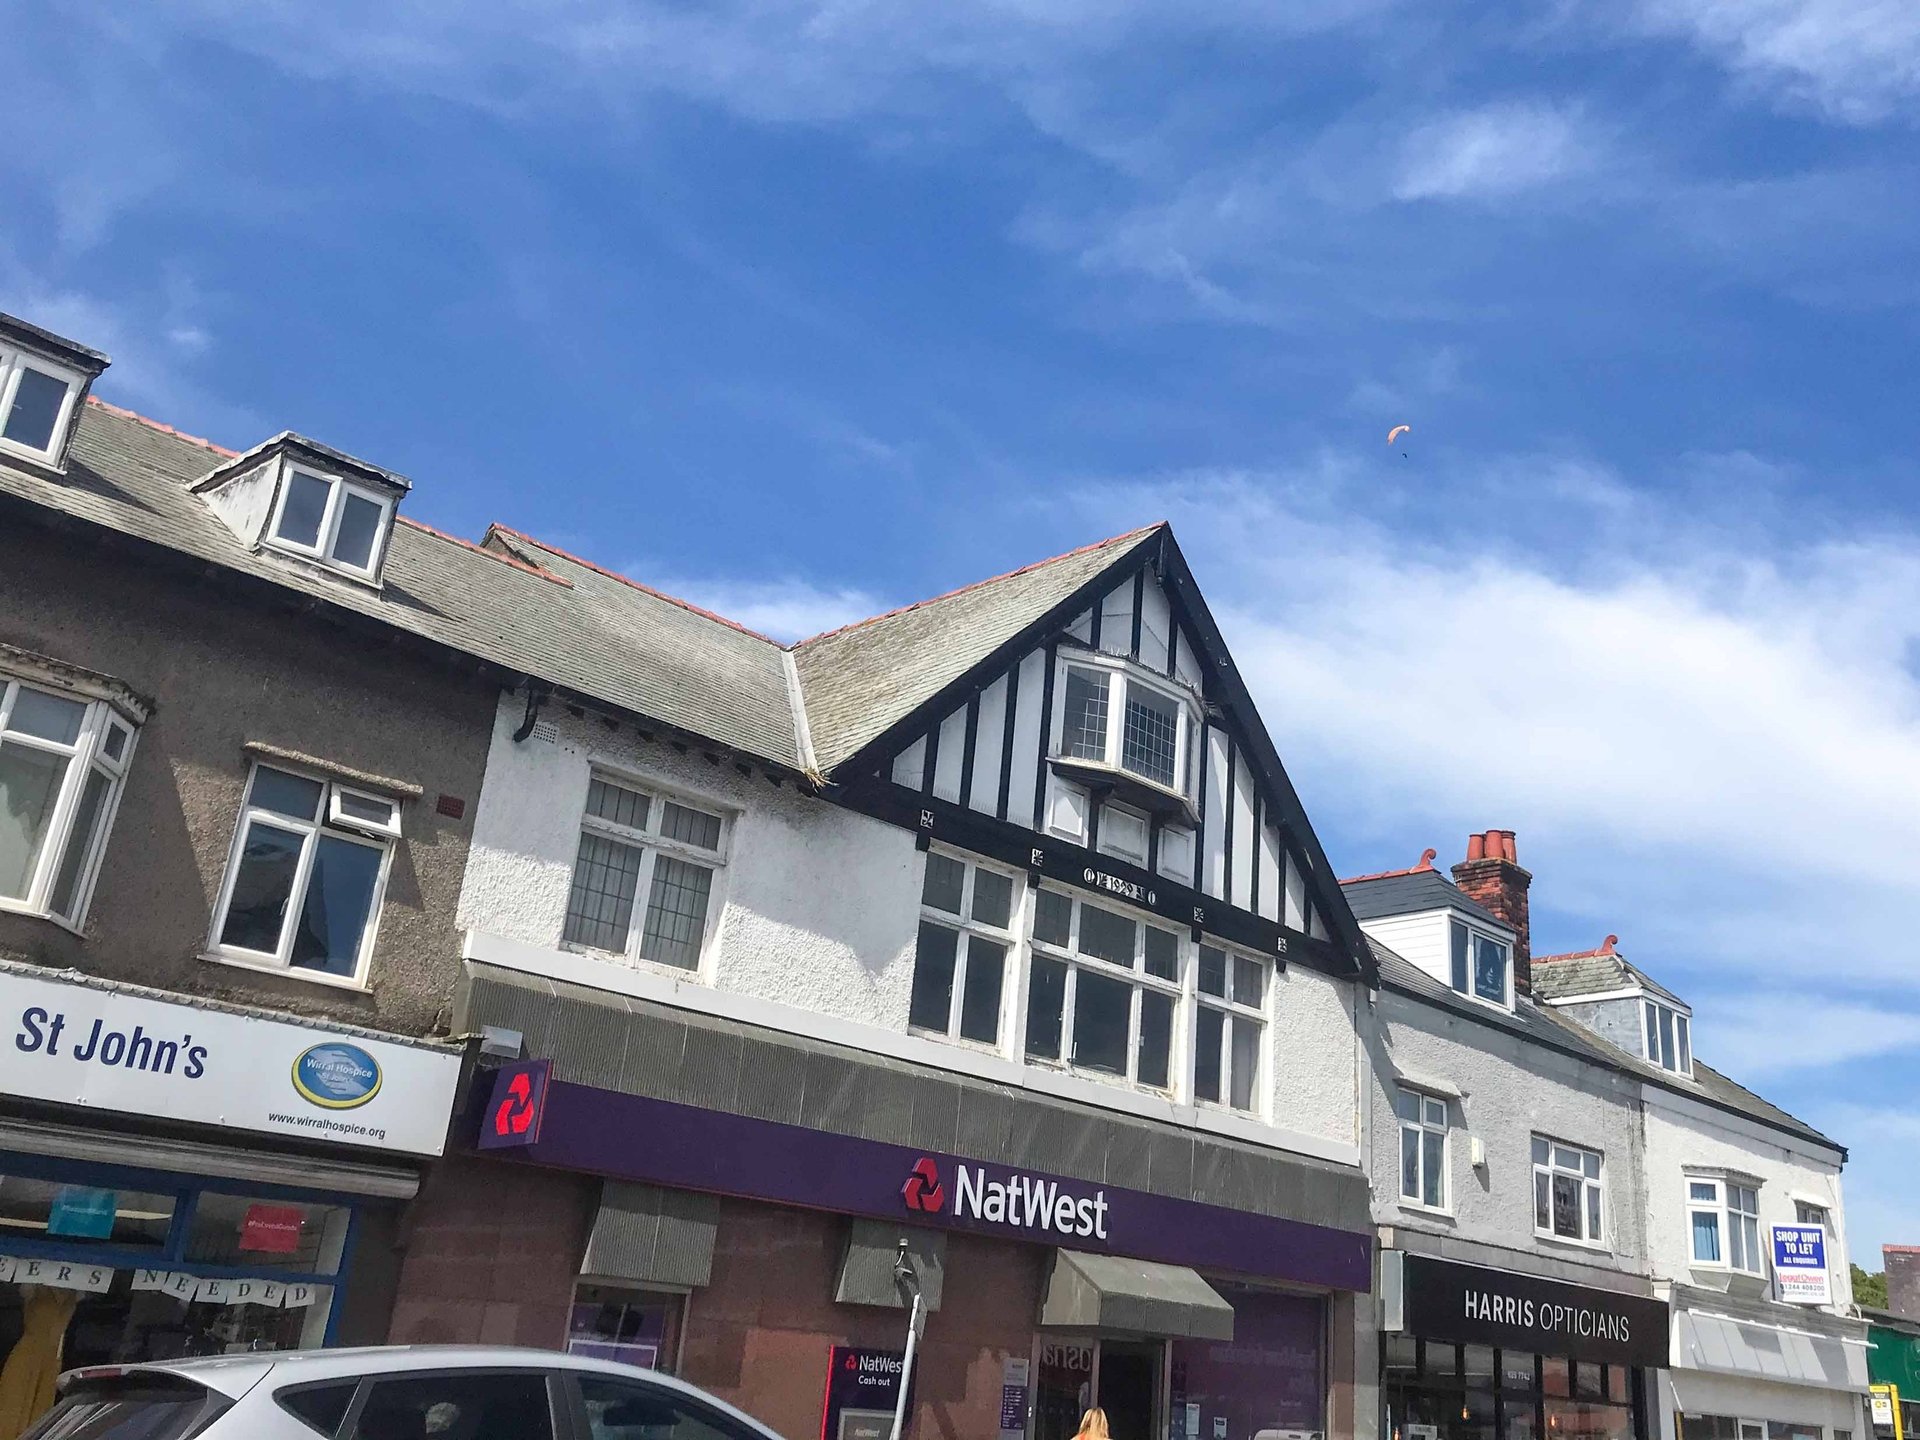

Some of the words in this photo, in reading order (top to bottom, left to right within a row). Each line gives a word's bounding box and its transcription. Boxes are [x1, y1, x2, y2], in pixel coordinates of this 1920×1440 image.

[15, 1006, 65, 1056] St
[73, 1018, 208, 1079] John's
[307, 1058, 334, 1072] Wirral
[335, 1063, 373, 1078] Hospice
[268, 1112, 386, 1140] www.wirralhospice.org
[954, 1164, 1108, 1240] NatWest
[1776, 1230, 1799, 1243] SHOP
[1801, 1231, 1820, 1244] UNIT
[1785, 1242, 1797, 1254] TO
[1799, 1243, 1813, 1255] LET
[1783, 1256, 1792, 1264] ALL
[143, 1268, 311, 1301] NEEDED
[1465, 1289, 1534, 1328] HARRIS
[1540, 1302, 1630, 1342] OPTICIANS
[859, 1355, 904, 1374] NatWes
[858, 1375, 877, 1385] Cash
[877, 1378, 890, 1386] out
